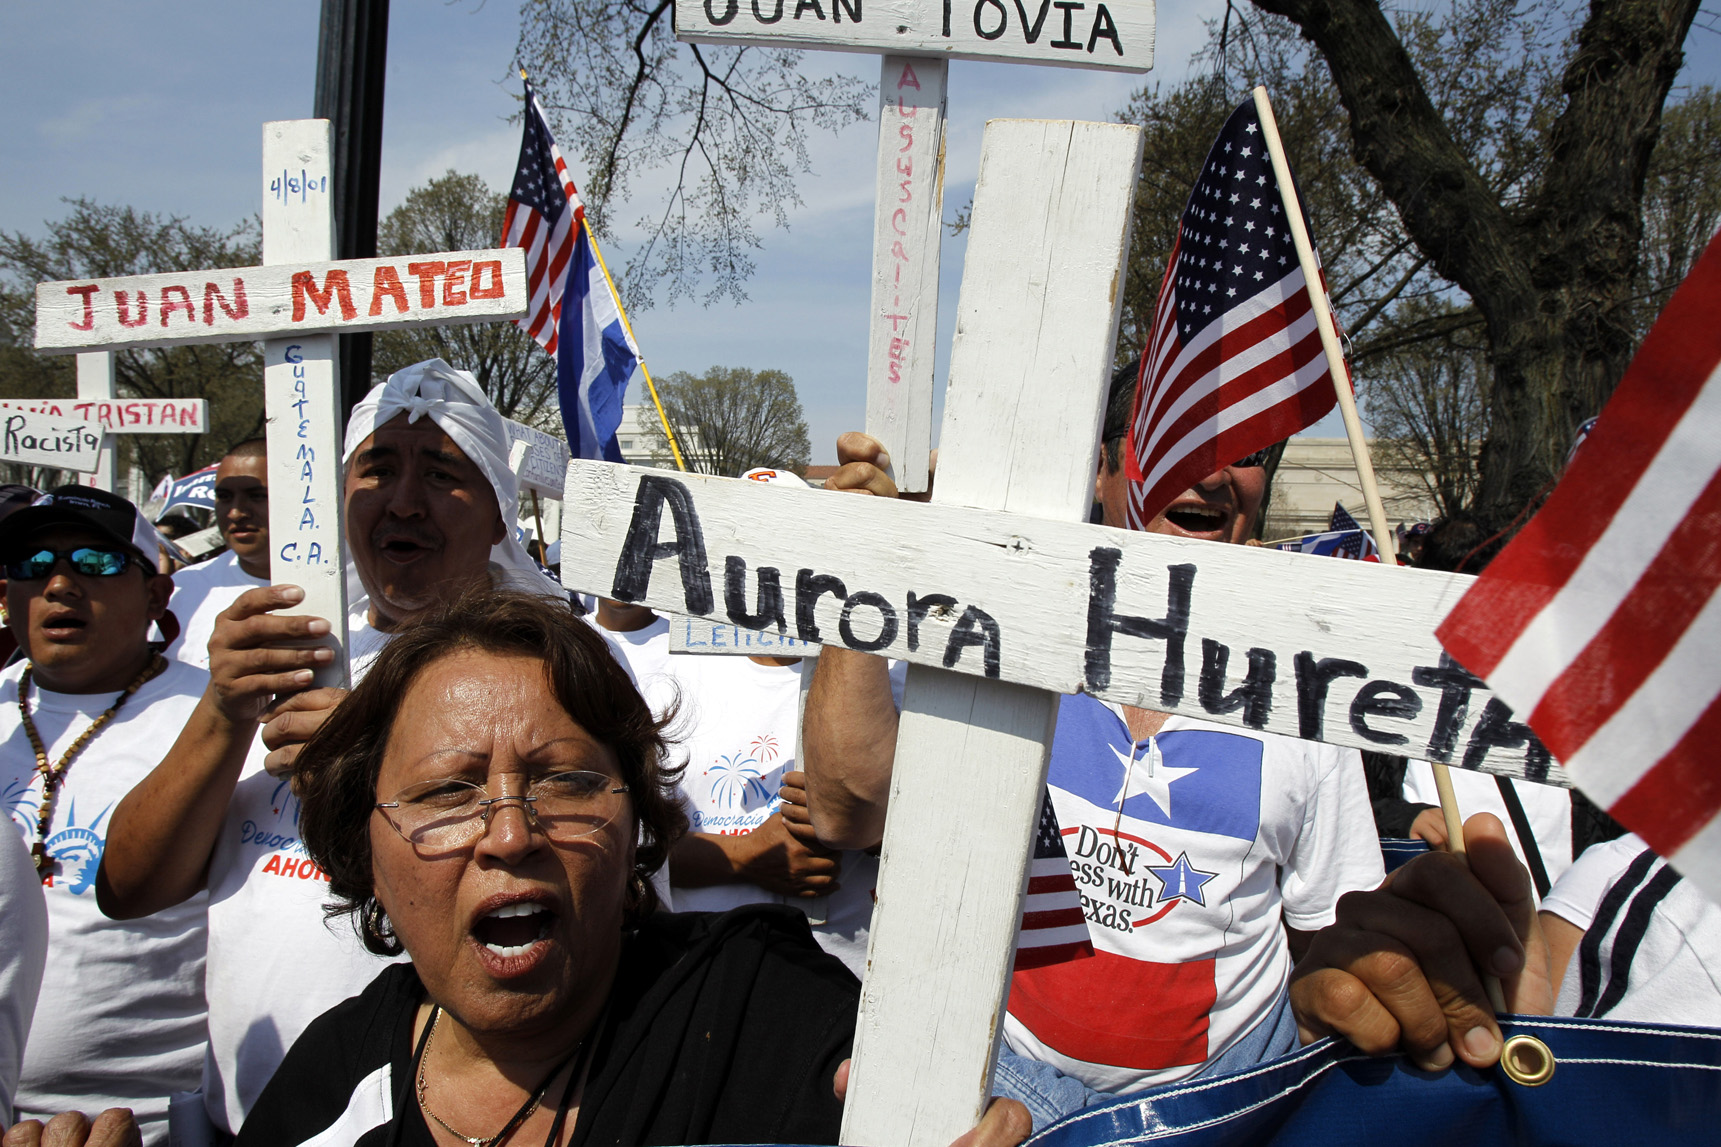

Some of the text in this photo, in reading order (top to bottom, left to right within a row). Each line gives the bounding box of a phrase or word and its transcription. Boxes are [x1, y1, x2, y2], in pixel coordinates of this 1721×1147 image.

[67, 260, 505, 331] JUAN MATEO
[73, 402, 198, 429] TRISTAN
[692, 811, 763, 827] Democracia
[1075, 824, 1139, 875] Don't
[1069, 860, 1154, 909] ess with
[1077, 888, 1133, 934] exas.
